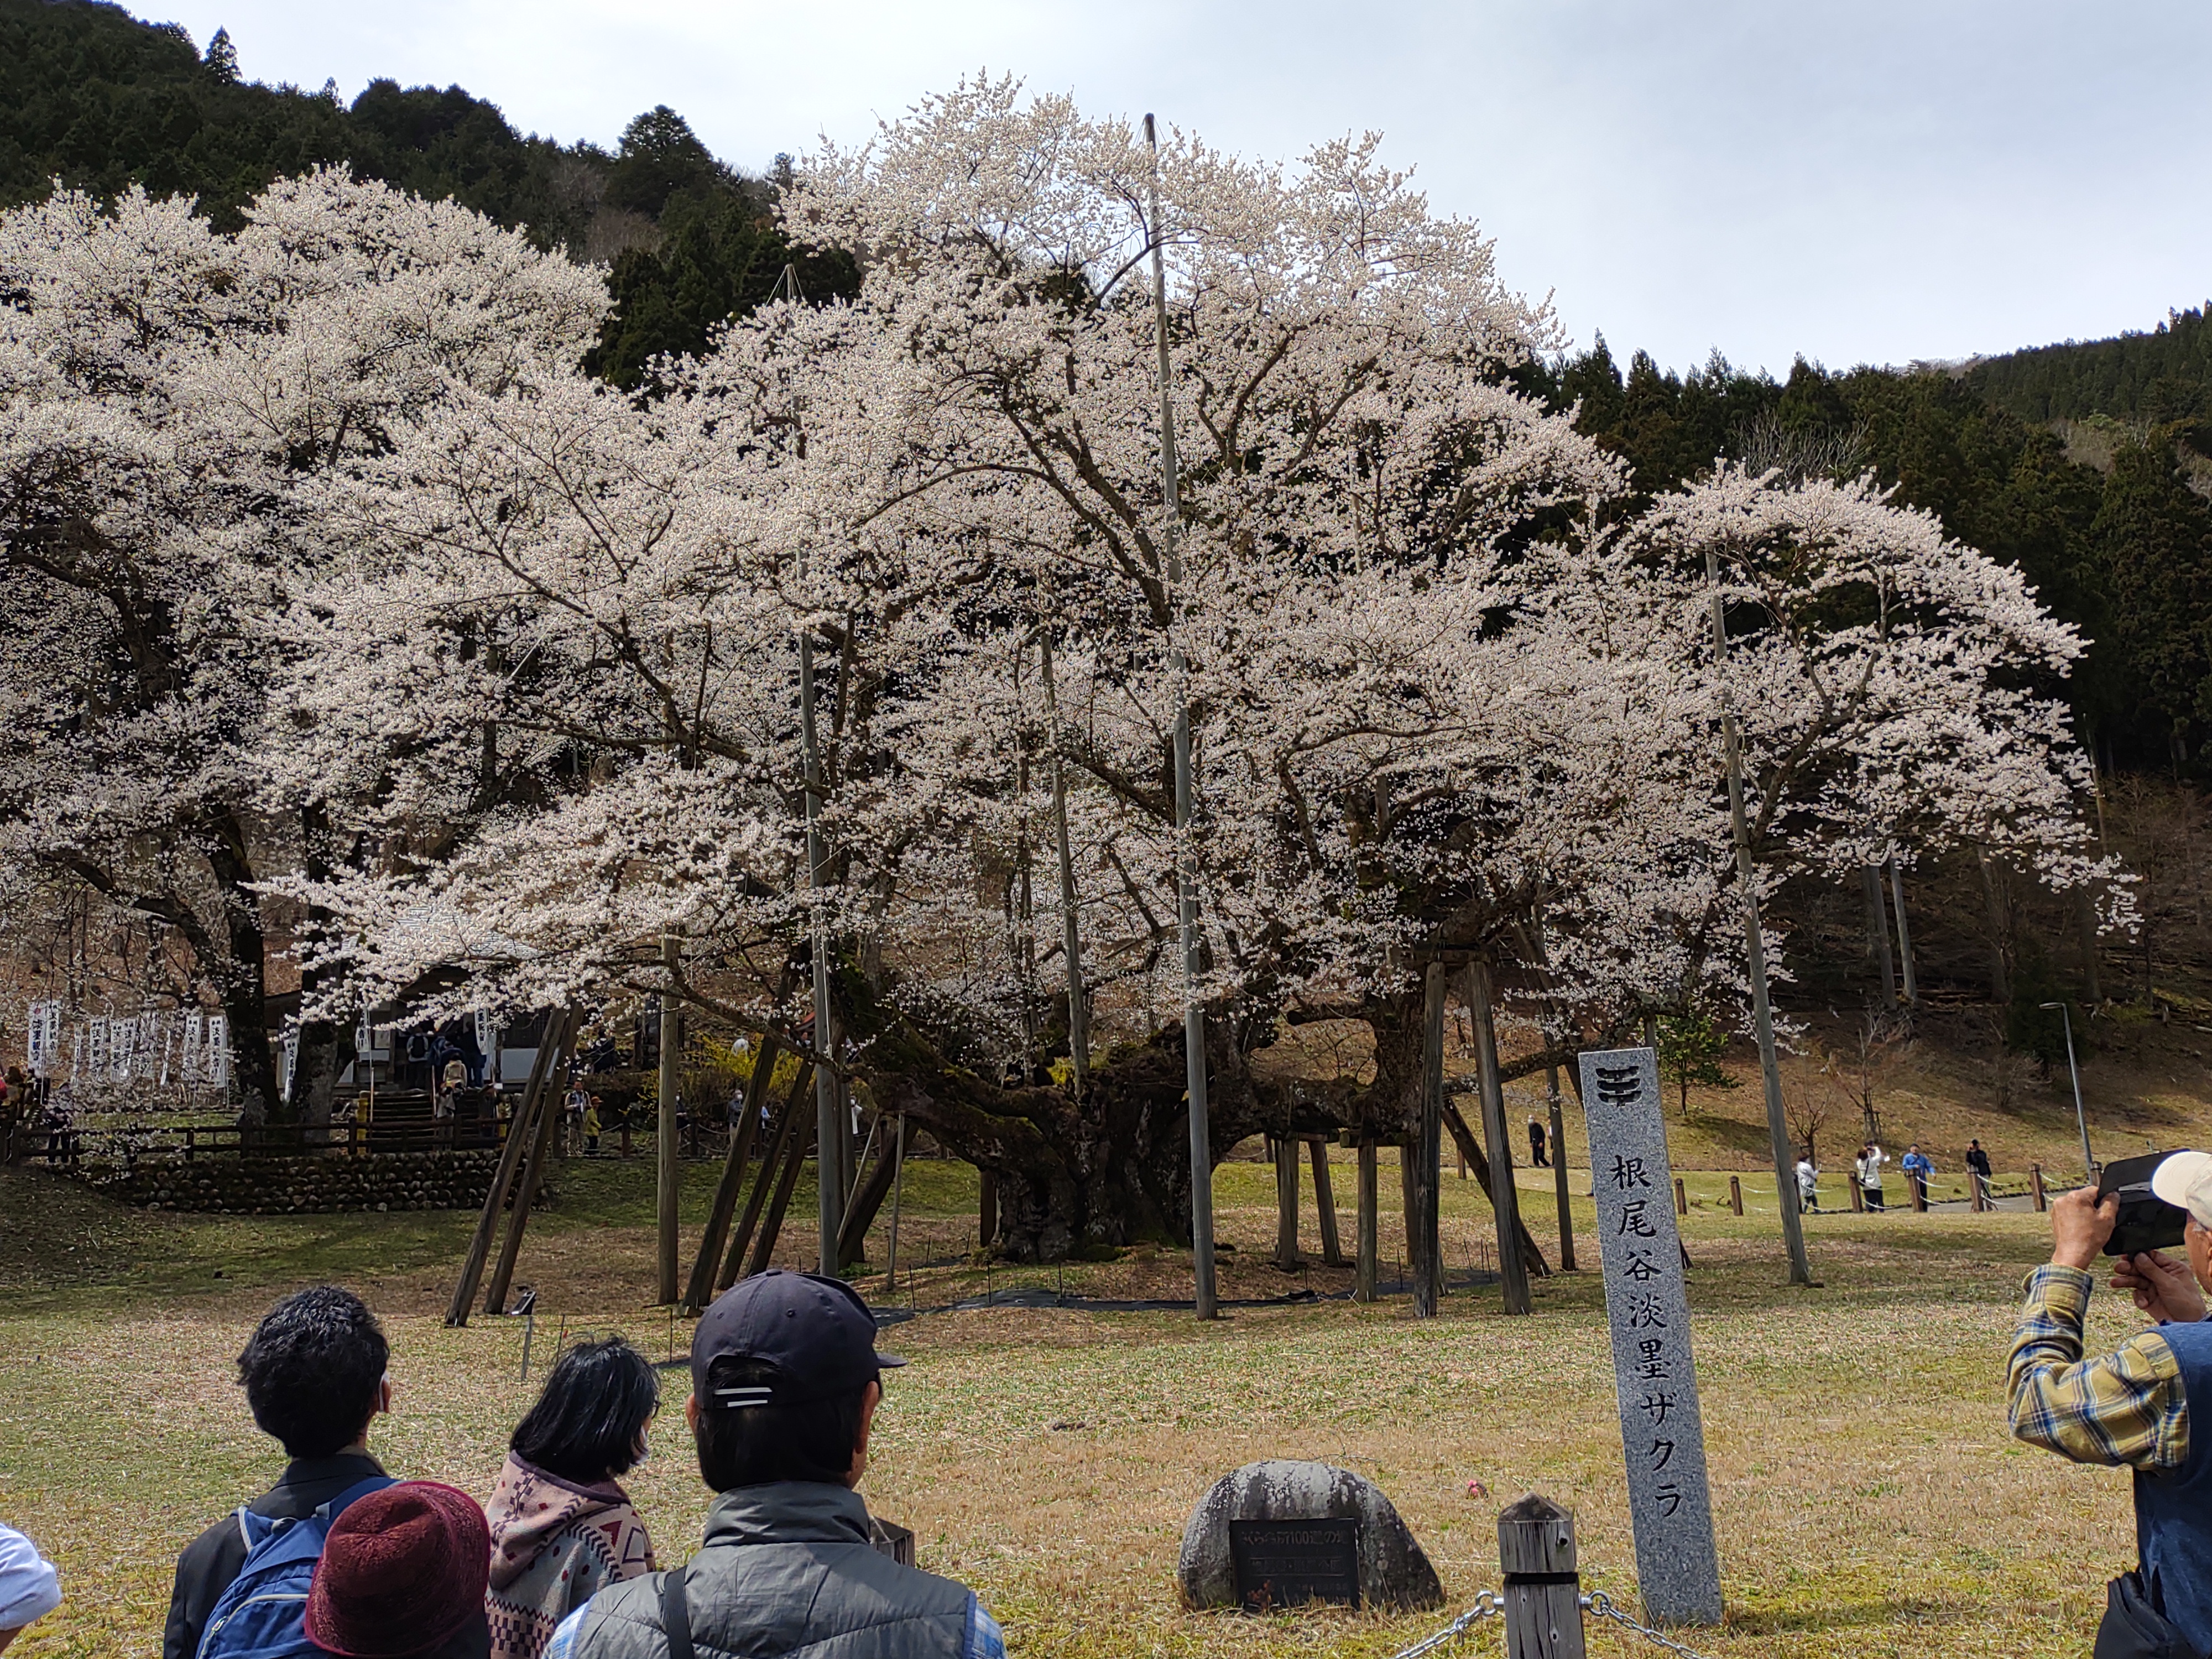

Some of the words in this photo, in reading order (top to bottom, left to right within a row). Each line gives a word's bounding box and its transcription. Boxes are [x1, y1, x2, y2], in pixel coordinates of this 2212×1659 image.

[1610, 1154, 1683, 1519] 根尾谷淡墨ザクラ
